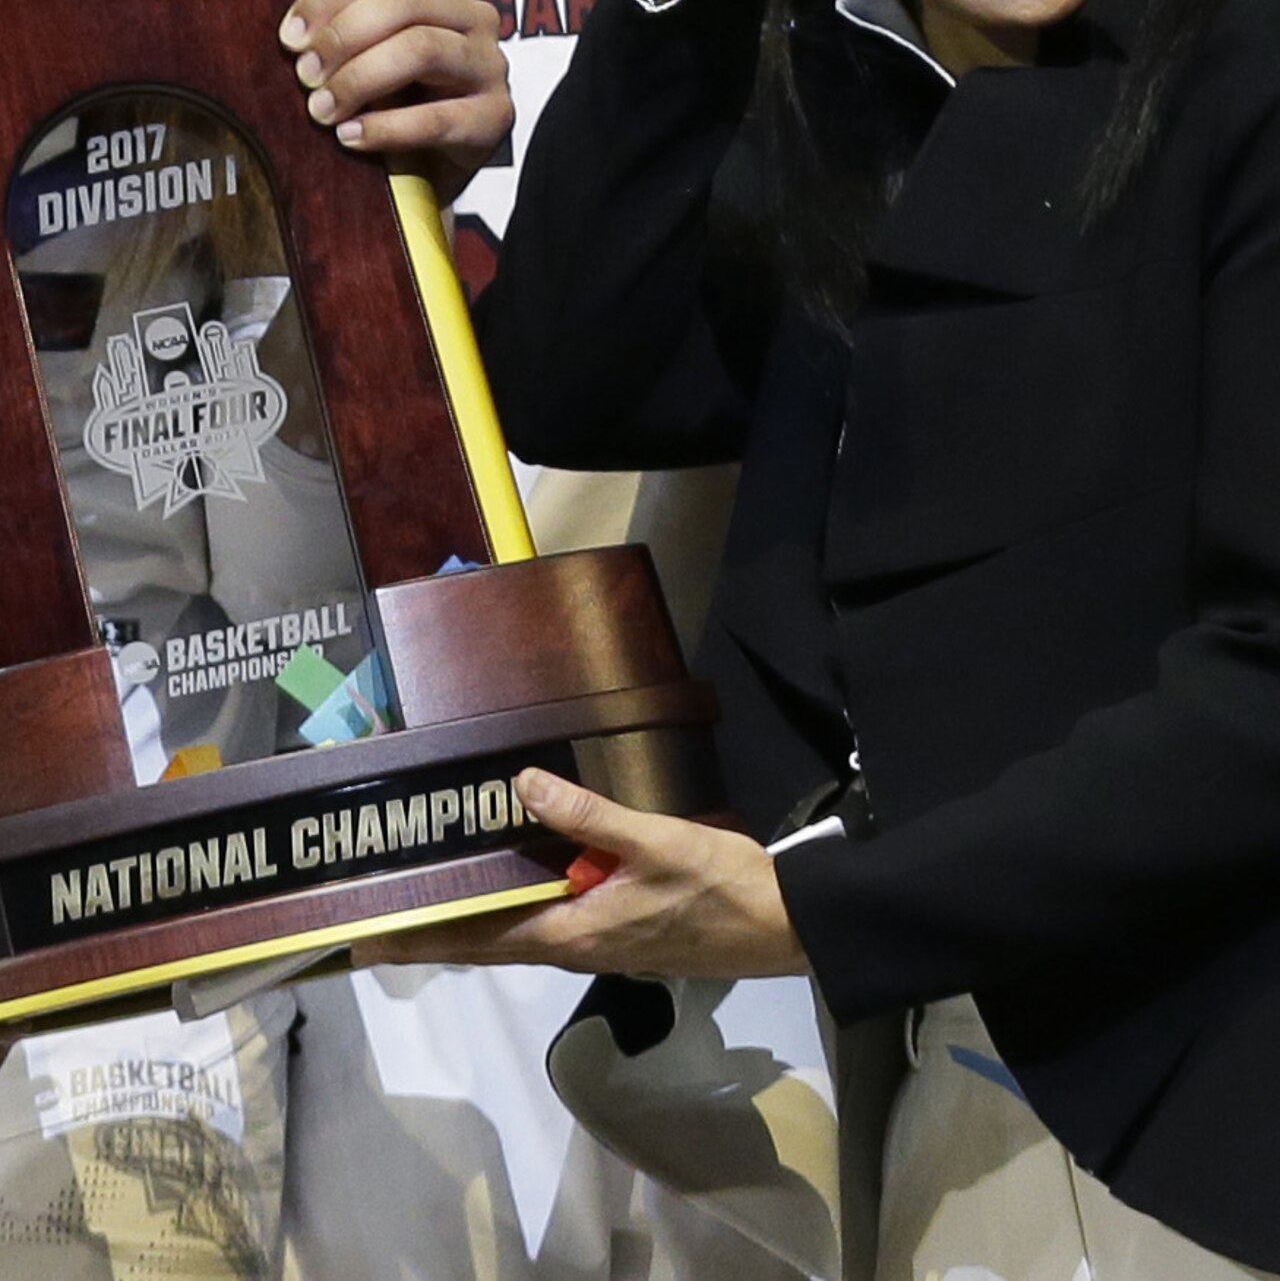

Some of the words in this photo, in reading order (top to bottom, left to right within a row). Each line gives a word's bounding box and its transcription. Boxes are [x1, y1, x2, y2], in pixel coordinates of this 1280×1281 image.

[87, 124, 167, 174] 2017
[38, 158, 213, 236] DIVISION
[225, 155, 237, 196] I
[152, 334, 189, 351] NCAA
[104, 408, 185, 454] FINAL
[192, 390, 267, 434] FOUR
[145, 388, 217, 411] WOMEN'S
[141, 437, 198, 459] DALLAS
[165, 602, 352, 673] BASKETBALL
[168, 643, 324, 698] CHAMPIONSP
[51, 827, 278, 925] NATIONAL
